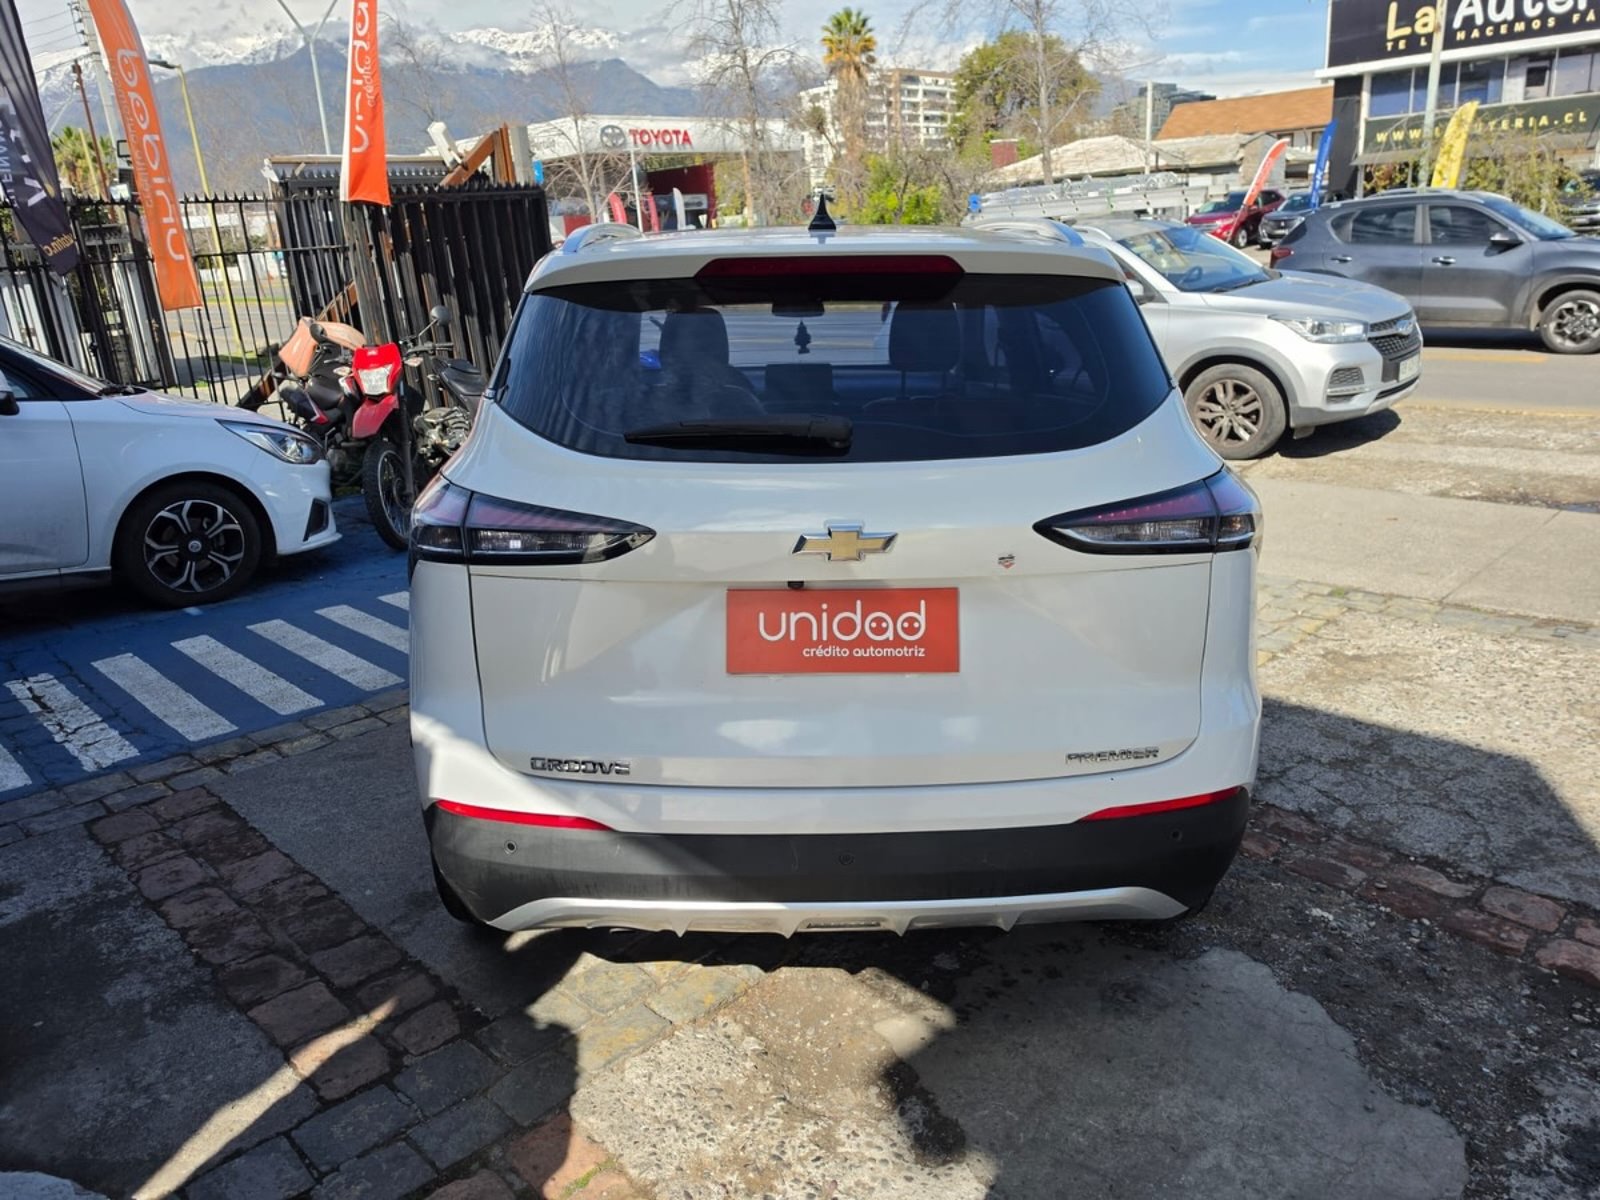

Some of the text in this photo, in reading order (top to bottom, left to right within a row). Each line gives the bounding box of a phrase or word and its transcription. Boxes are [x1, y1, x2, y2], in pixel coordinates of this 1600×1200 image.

[1387, 2, 1436, 39] La
[1387, 41, 1406, 51] TE
[1456, 17, 1555, 41] HACEMOS
[629, 128, 692, 146] TOYOTA
[758, 600, 926, 641] unidad
[802, 645, 926, 657] crédito automotriz
[1065, 746, 1159, 764] PREMIER
[530, 756, 631, 775] GROOVE
